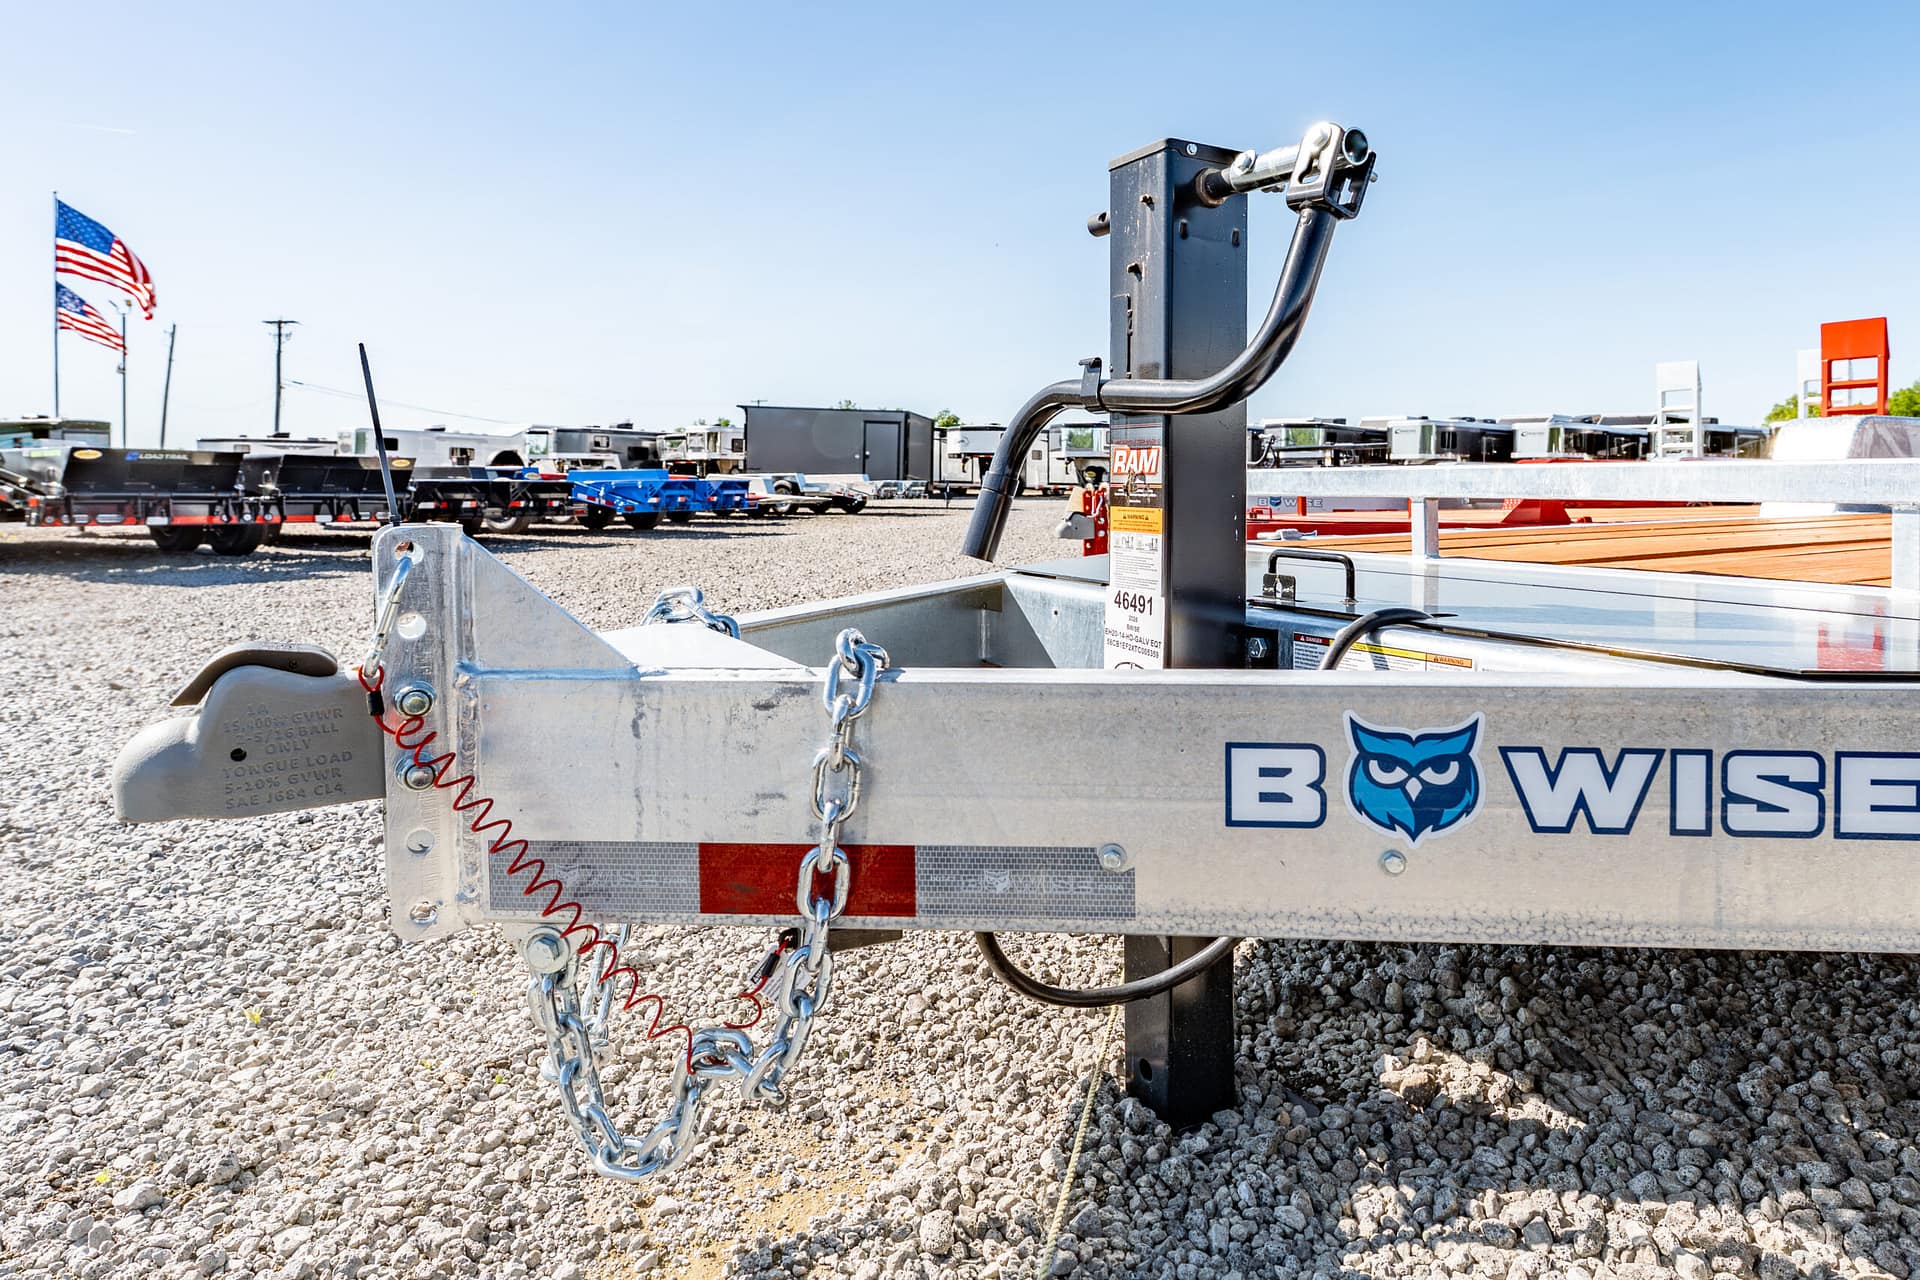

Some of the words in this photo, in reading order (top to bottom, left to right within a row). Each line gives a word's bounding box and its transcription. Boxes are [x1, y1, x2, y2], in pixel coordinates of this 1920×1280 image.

[1113, 448, 1159, 474] RAM
[1283, 498, 1323, 508] WSE
[1114, 590, 1153, 616] 46491
[1439, 655, 1464, 664] WARNING
[292, 708, 343, 724] GVWR
[265, 738, 311, 755] ONLY
[223, 759, 299, 779] TONGUE
[305, 751, 353, 767] LOAD
[287, 767, 342, 785] GVWR
[225, 795, 259, 810] SAE
[266, 788, 306, 803] J684
[1225, 742, 1327, 829] B
[1498, 746, 1920, 841] WISE
